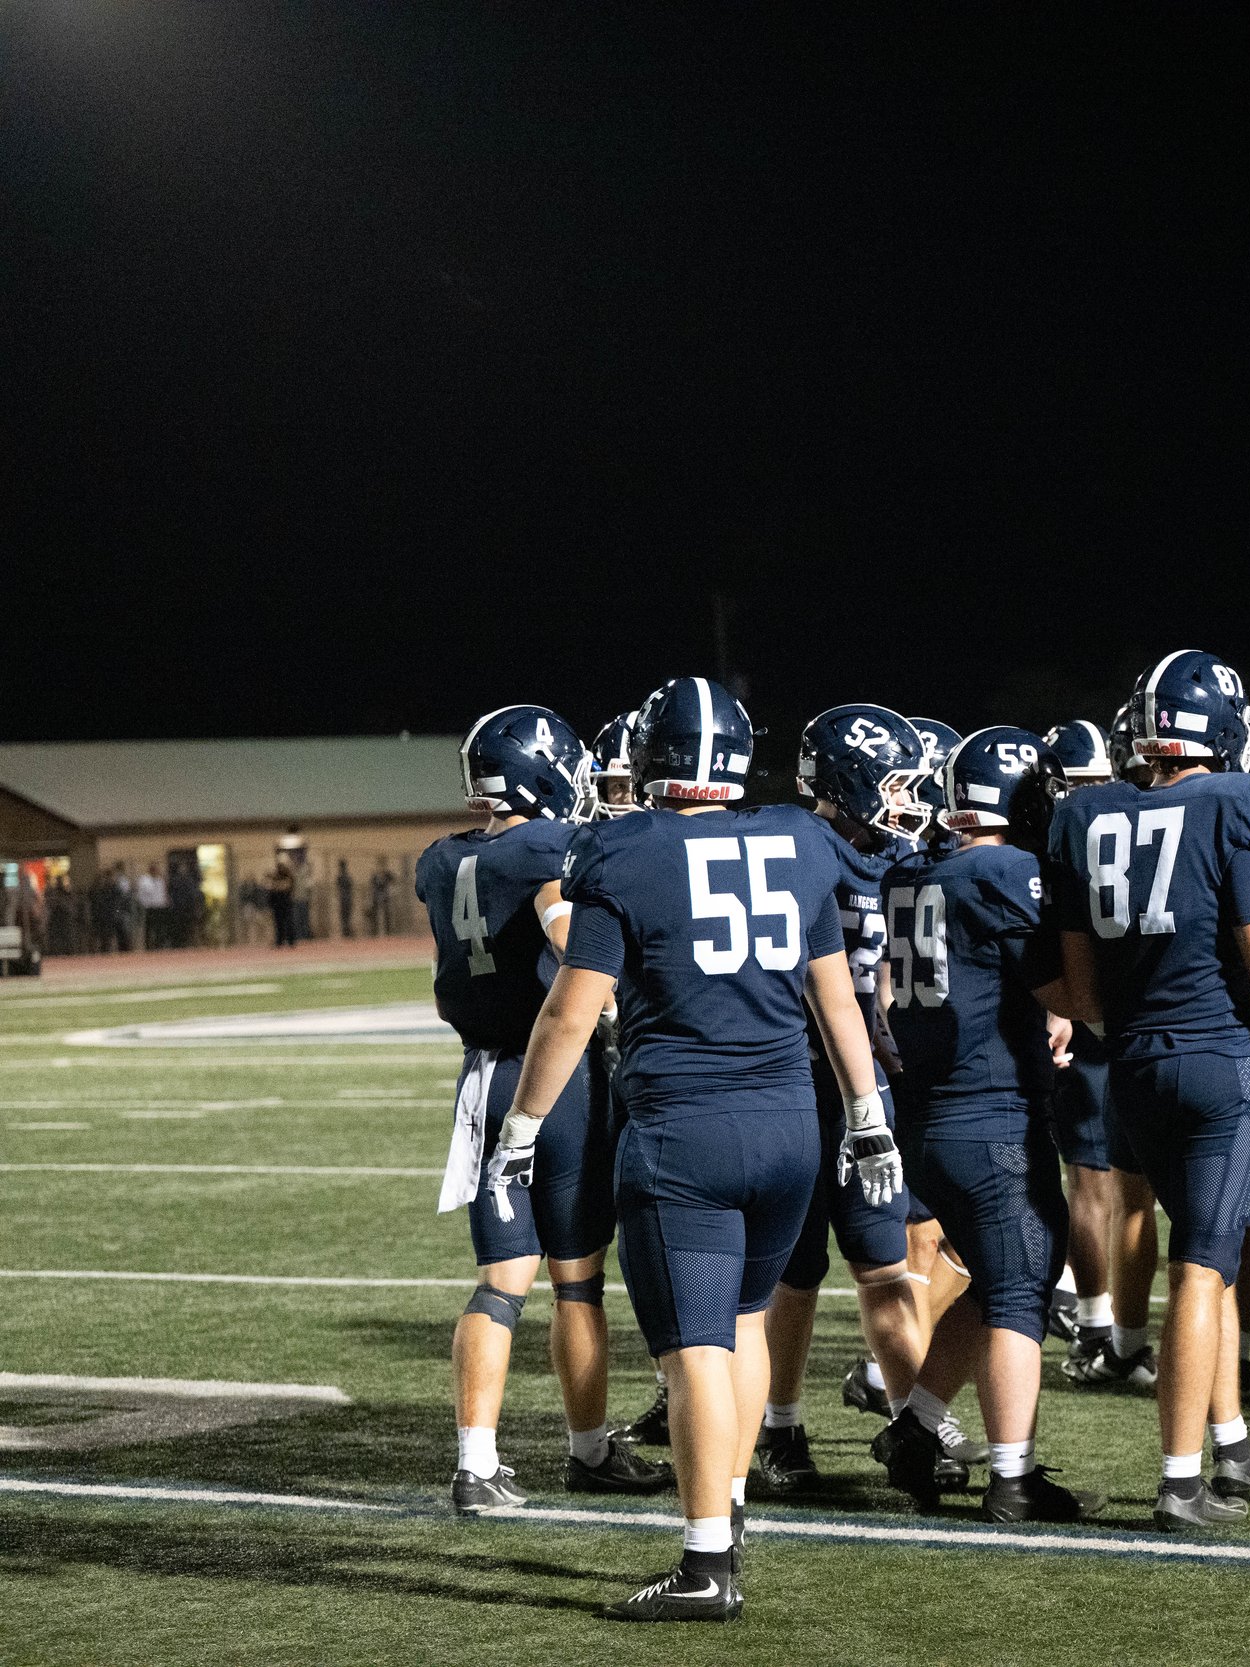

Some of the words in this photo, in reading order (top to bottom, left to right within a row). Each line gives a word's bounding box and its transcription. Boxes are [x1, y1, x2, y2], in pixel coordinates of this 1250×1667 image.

[1212, 664, 1245, 699] 87
[536, 718, 554, 746] 4
[845, 717, 890, 759] 52
[997, 743, 1039, 775] 59
[667, 782, 730, 799] Riddell
[1087, 805, 1185, 939] 87
[452, 855, 496, 977] 4
[684, 835, 801, 975] 55
[849, 894, 878, 911] RANGERS
[888, 884, 950, 1009] 59
